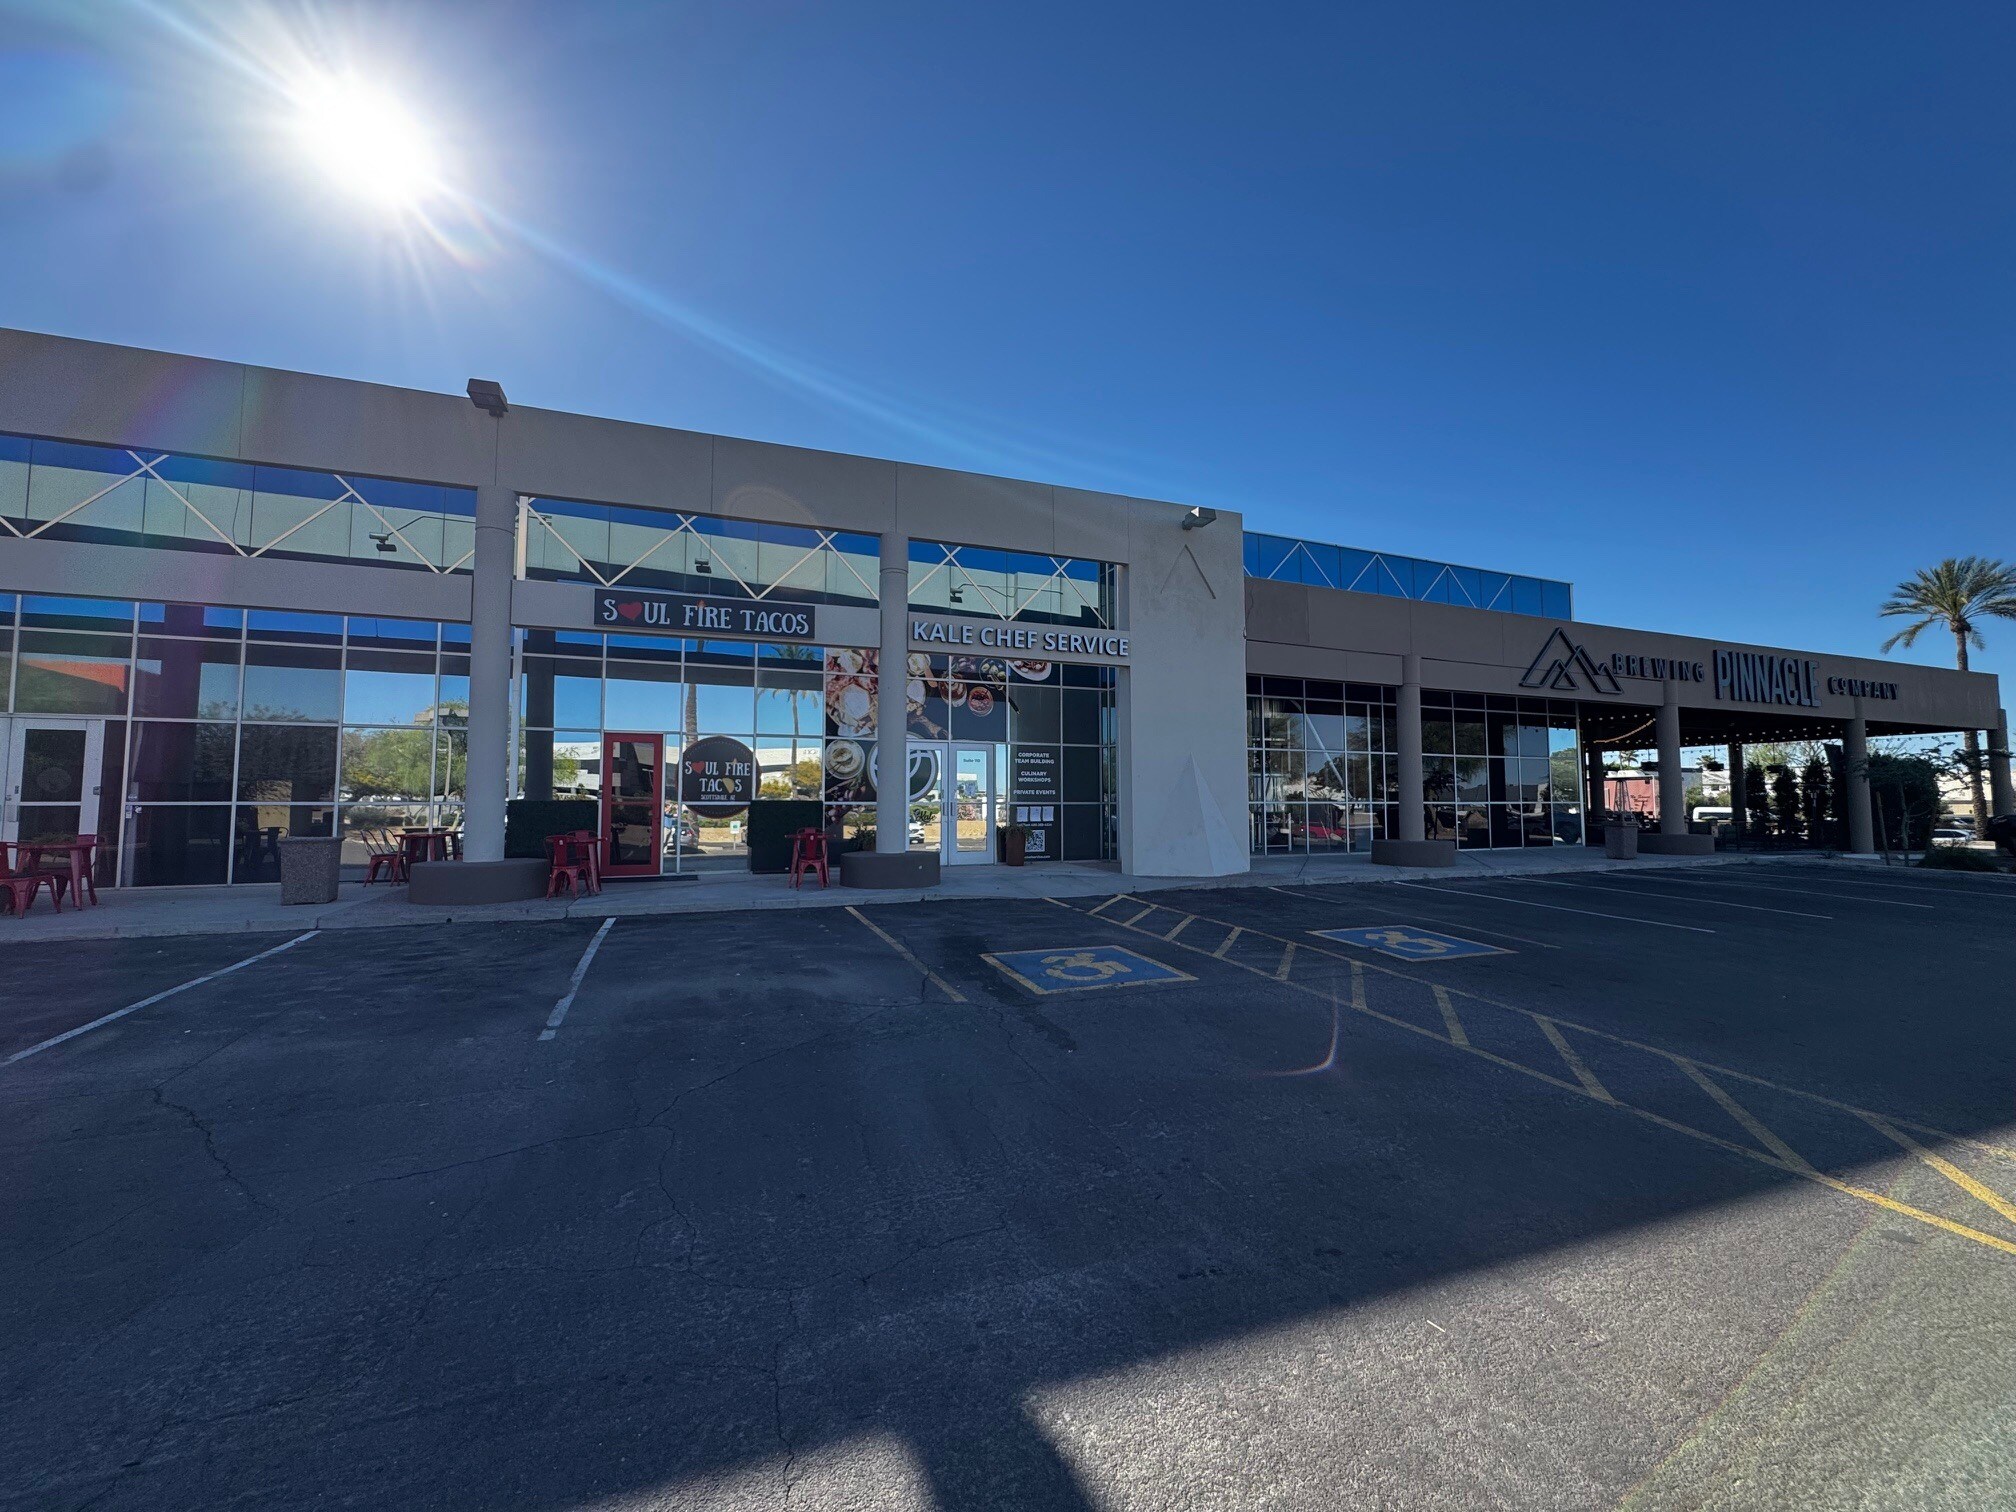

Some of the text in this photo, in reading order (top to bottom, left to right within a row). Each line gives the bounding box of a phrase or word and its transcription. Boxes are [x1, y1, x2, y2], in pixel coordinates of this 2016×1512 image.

[603, 598, 809, 635] SUL FIRE TACOS
[912, 620, 1129, 656] KALE CHEF SERVICE
[1612, 649, 1899, 707] BREWING PINNACLE COMPANY
[685, 759, 751, 776] SUL FIRE
[699, 777, 743, 793] TACS
